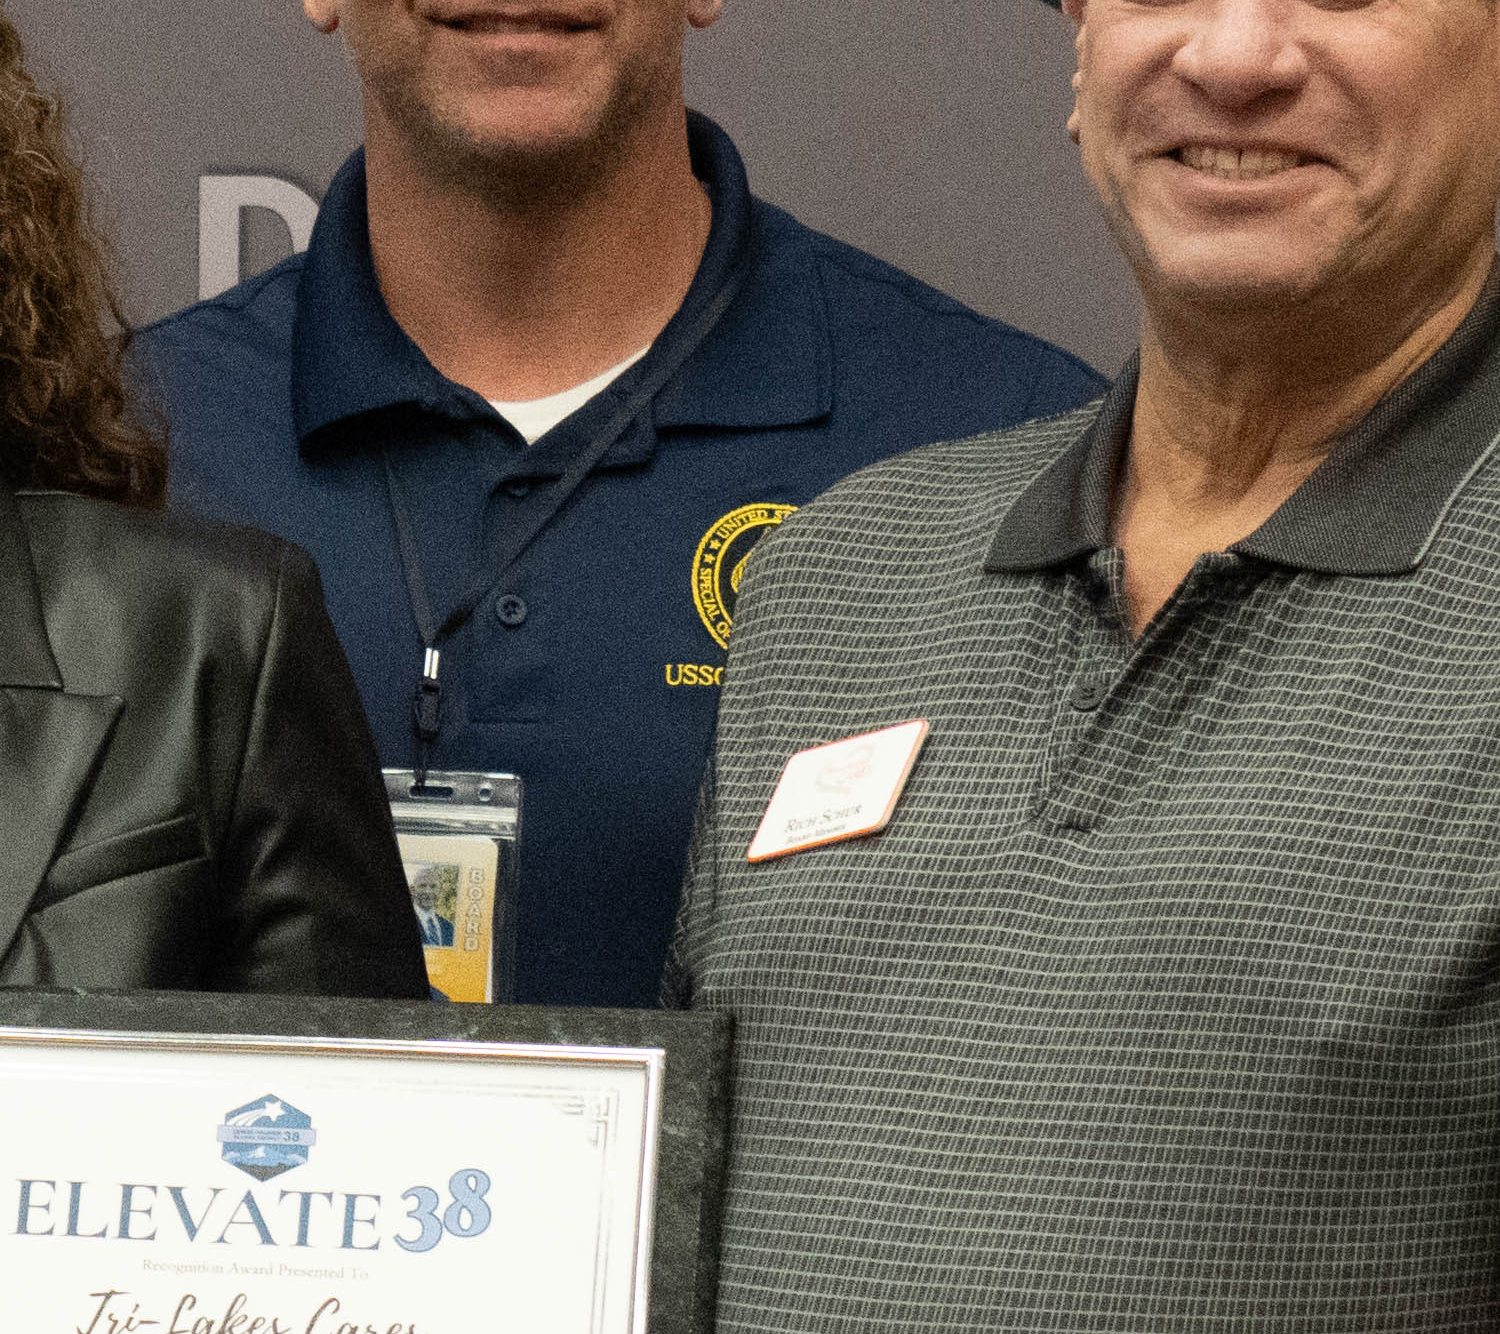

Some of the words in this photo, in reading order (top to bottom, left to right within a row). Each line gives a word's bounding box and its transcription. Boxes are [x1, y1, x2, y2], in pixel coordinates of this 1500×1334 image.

[716, 509, 769, 539] UNITED
[699, 567, 721, 621] SPECIAL
[463, 866, 485, 951] BOARD
[142, 1258, 223, 1276] Recognition
[228, 1260, 273, 1275] Award
[278, 1262, 343, 1278] Presented
